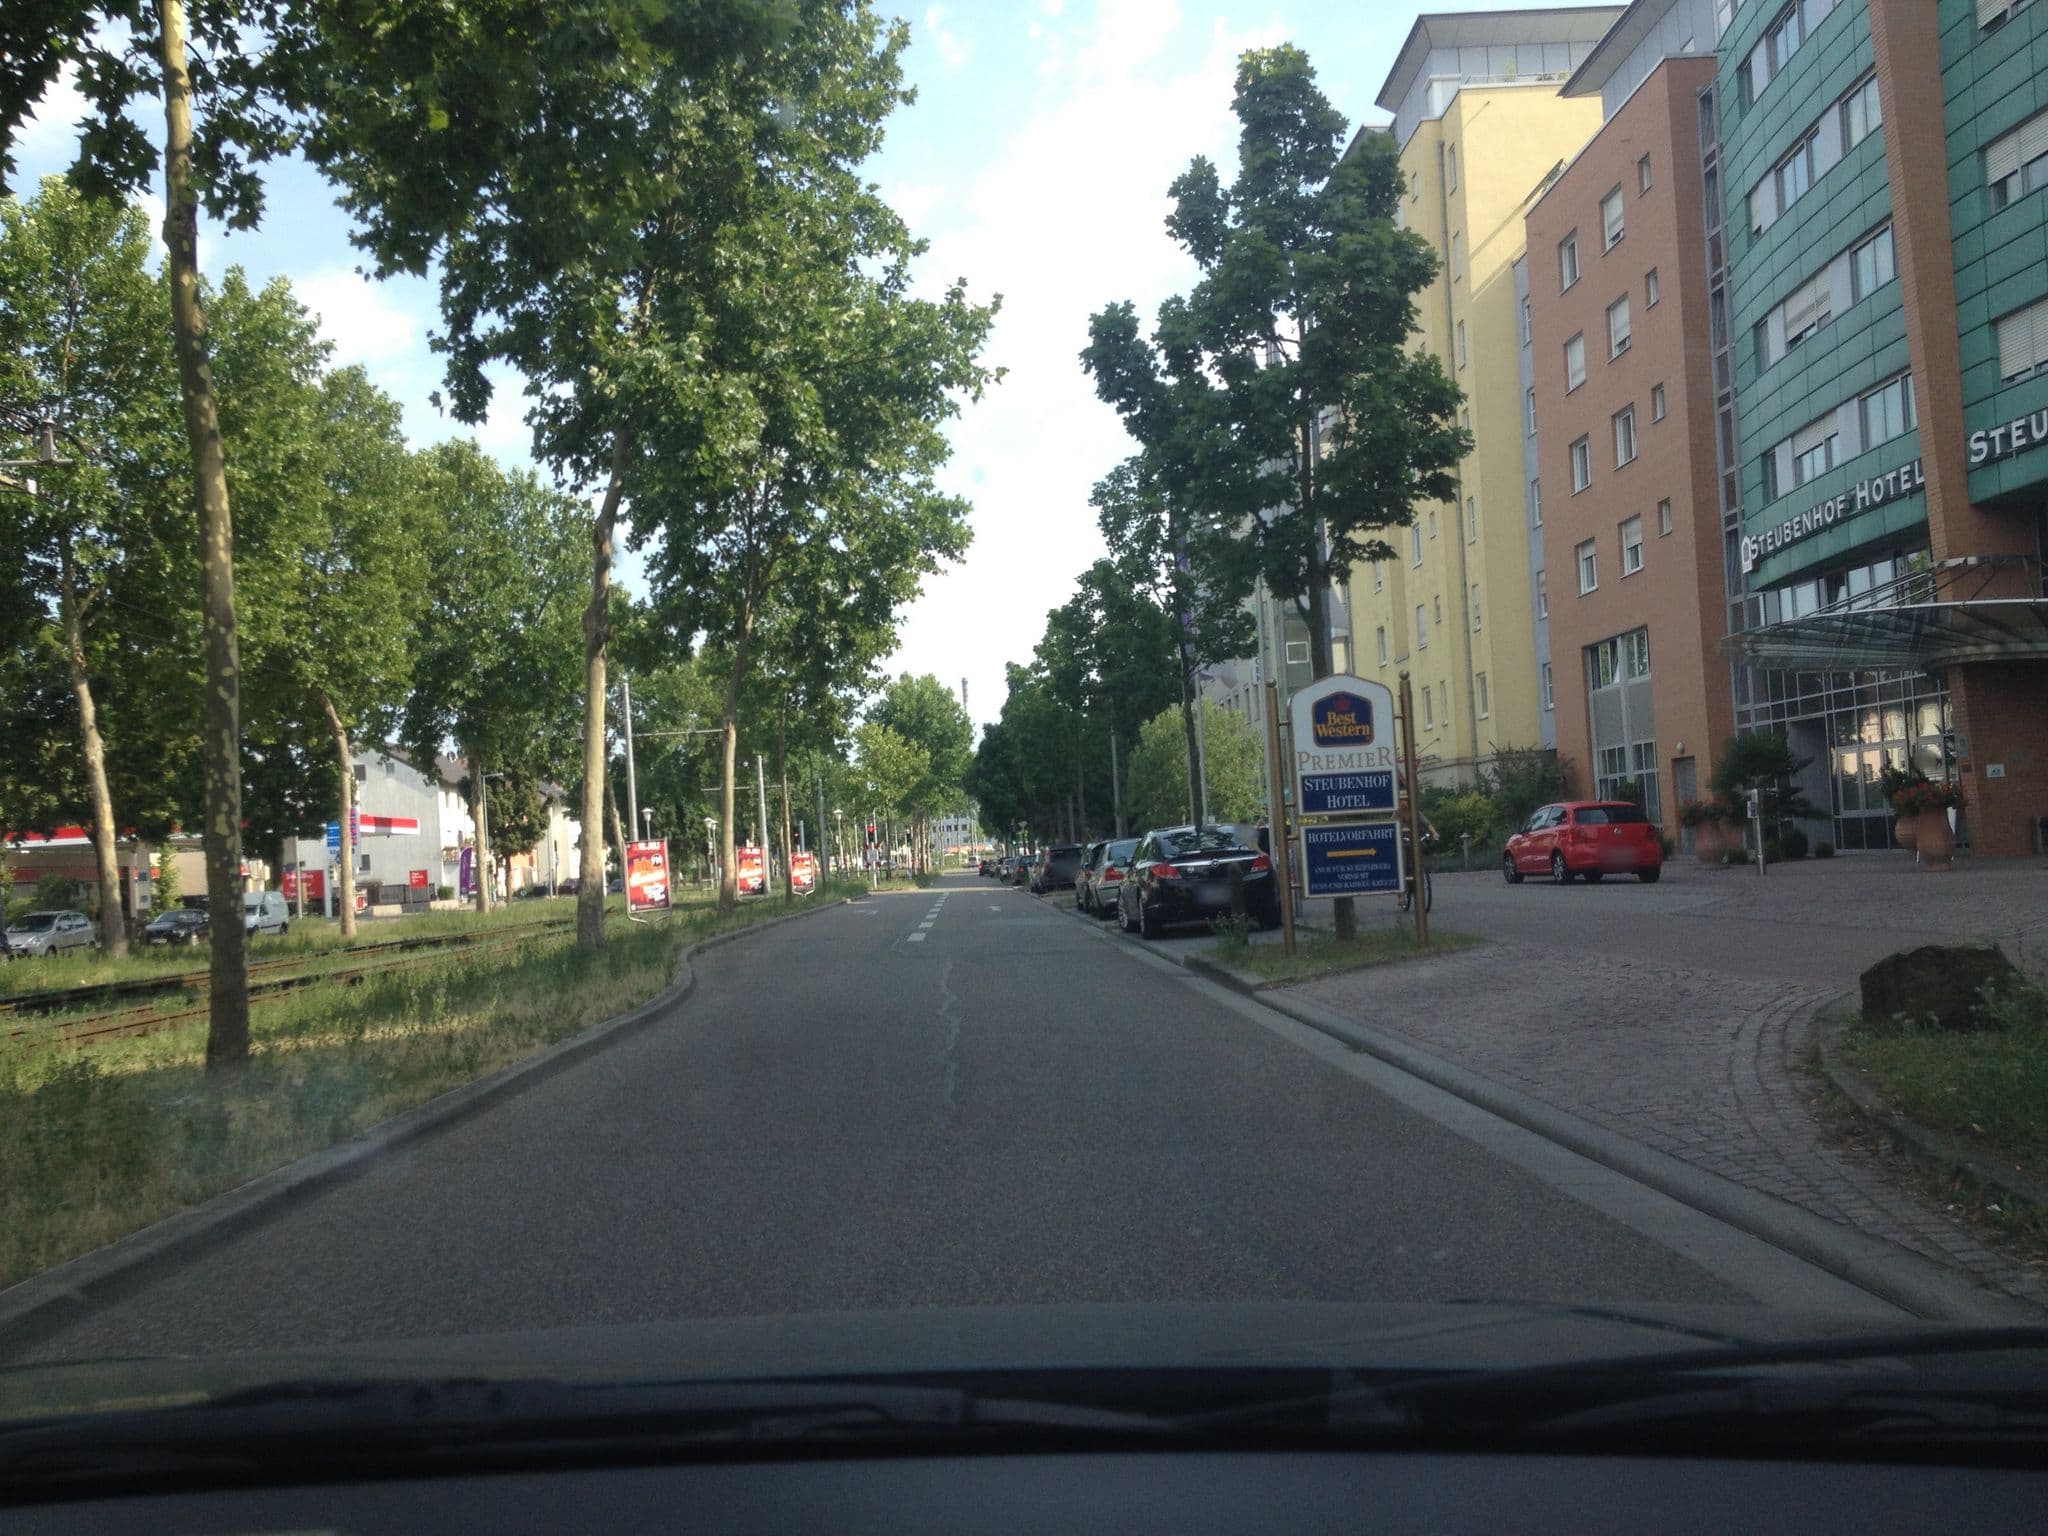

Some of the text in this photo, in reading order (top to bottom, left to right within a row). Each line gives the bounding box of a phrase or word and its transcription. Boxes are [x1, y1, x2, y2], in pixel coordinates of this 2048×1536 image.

[1750, 460, 1925, 560] STEUBENHOF HOTEL
[1327, 711, 1356, 725] Best
[1316, 723, 1370, 738] Western
[1297, 747, 1394, 771] PREMIER
[1304, 775, 1390, 791] STEUBENHOF
[1327, 794, 1370, 809] HOTEL
